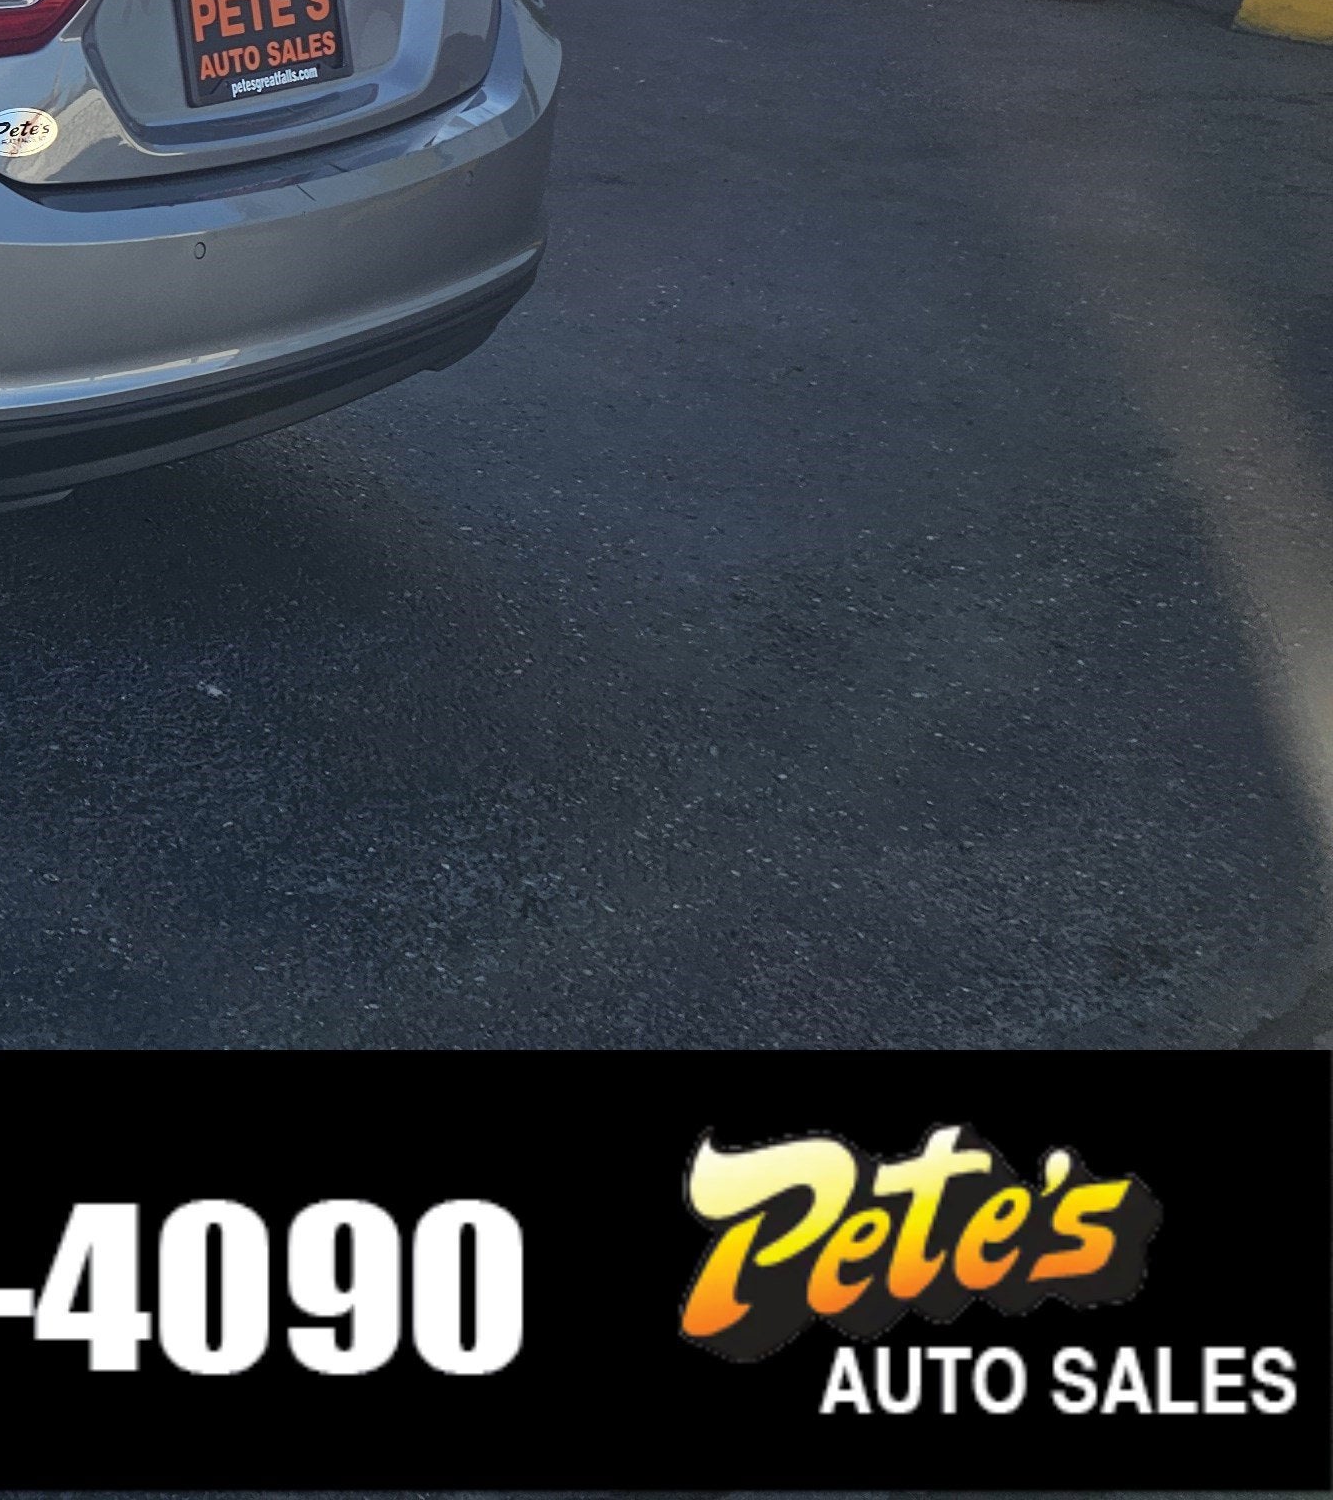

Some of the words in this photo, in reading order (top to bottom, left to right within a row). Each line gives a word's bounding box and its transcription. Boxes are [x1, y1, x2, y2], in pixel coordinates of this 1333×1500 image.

[200, 45, 261, 80] AUTO
[266, 31, 336, 67] SALES
[231, 67, 318, 98] petesgreatfalls.com
